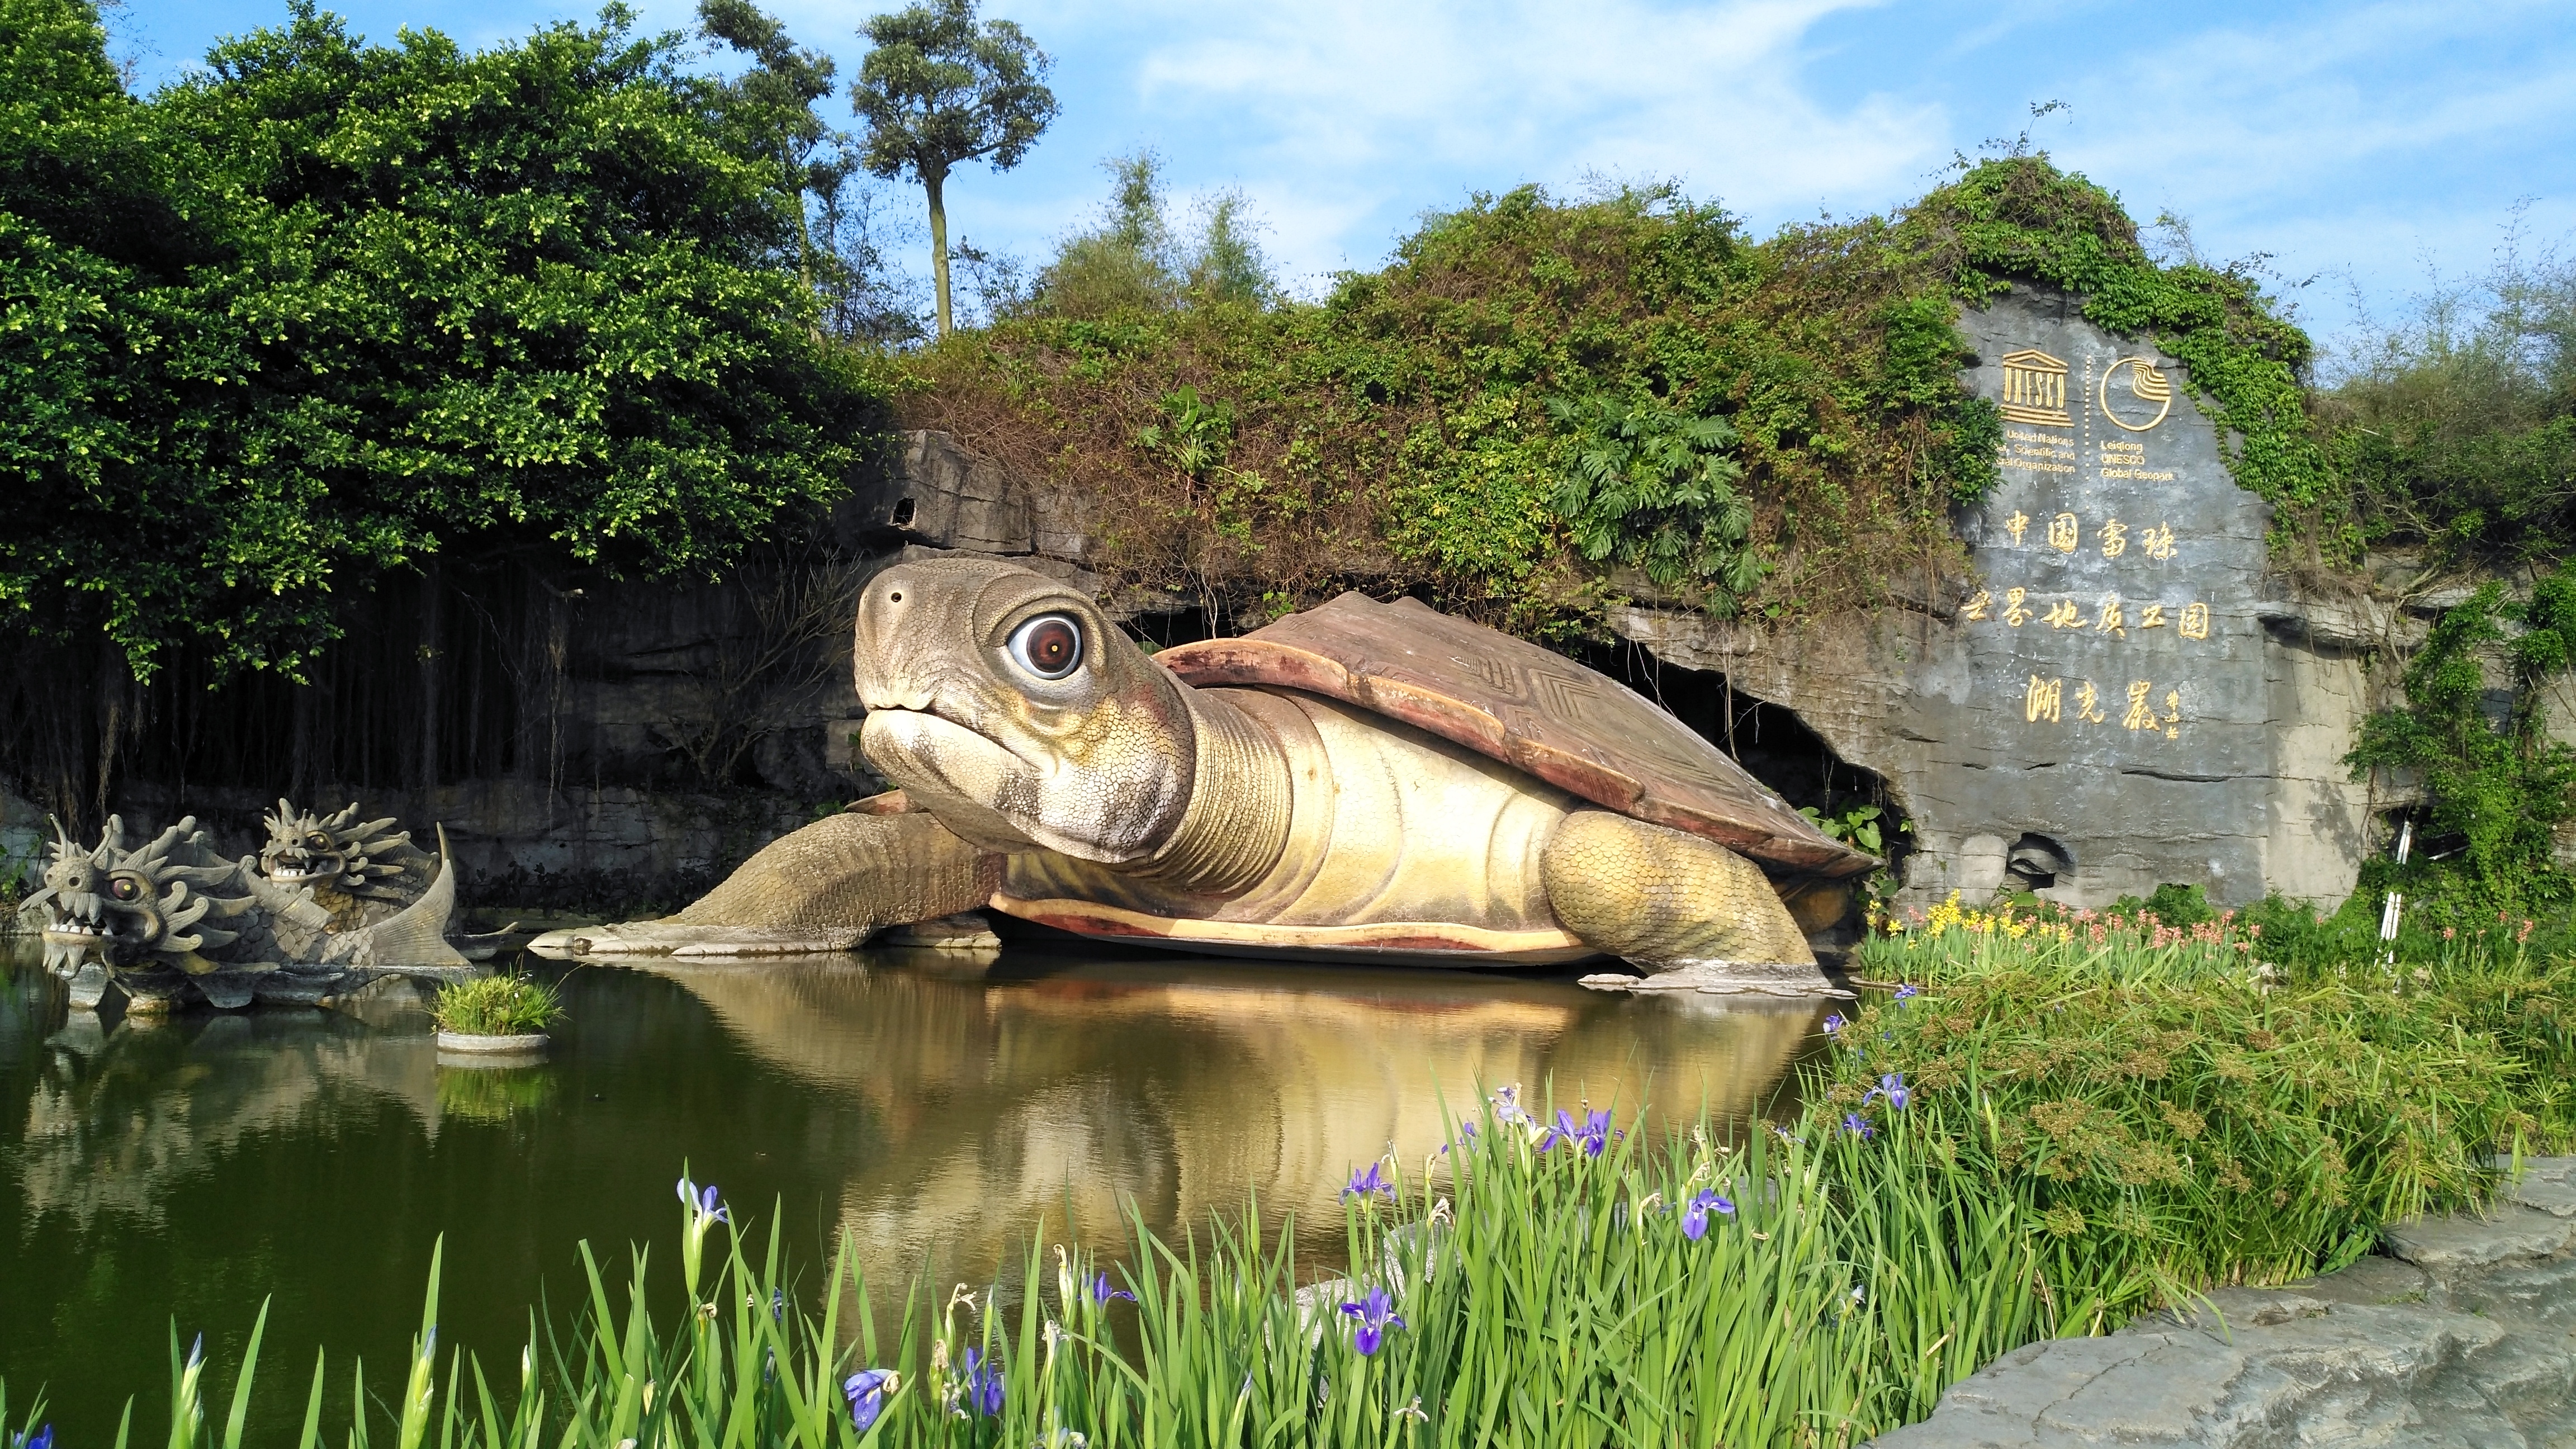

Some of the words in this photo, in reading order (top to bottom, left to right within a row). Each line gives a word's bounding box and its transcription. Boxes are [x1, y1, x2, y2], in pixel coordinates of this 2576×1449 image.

[2004, 367, 2065, 409] UNESCO
[2006, 429, 2037, 442] United
[2039, 433, 2075, 447] Nations
[2015, 444, 2056, 457] Scientific
[2058, 451, 2075, 460] and
[2101, 453, 2145, 465] UNESCO
[2014, 458, 2075, 473] Organization
[2101, 467, 2132, 479] Global
[2134, 468, 2174, 482] Geopark
[2006, 509, 2178, 560] 中国雷琼
[1960, 586, 2209, 640] 世界地质公园
